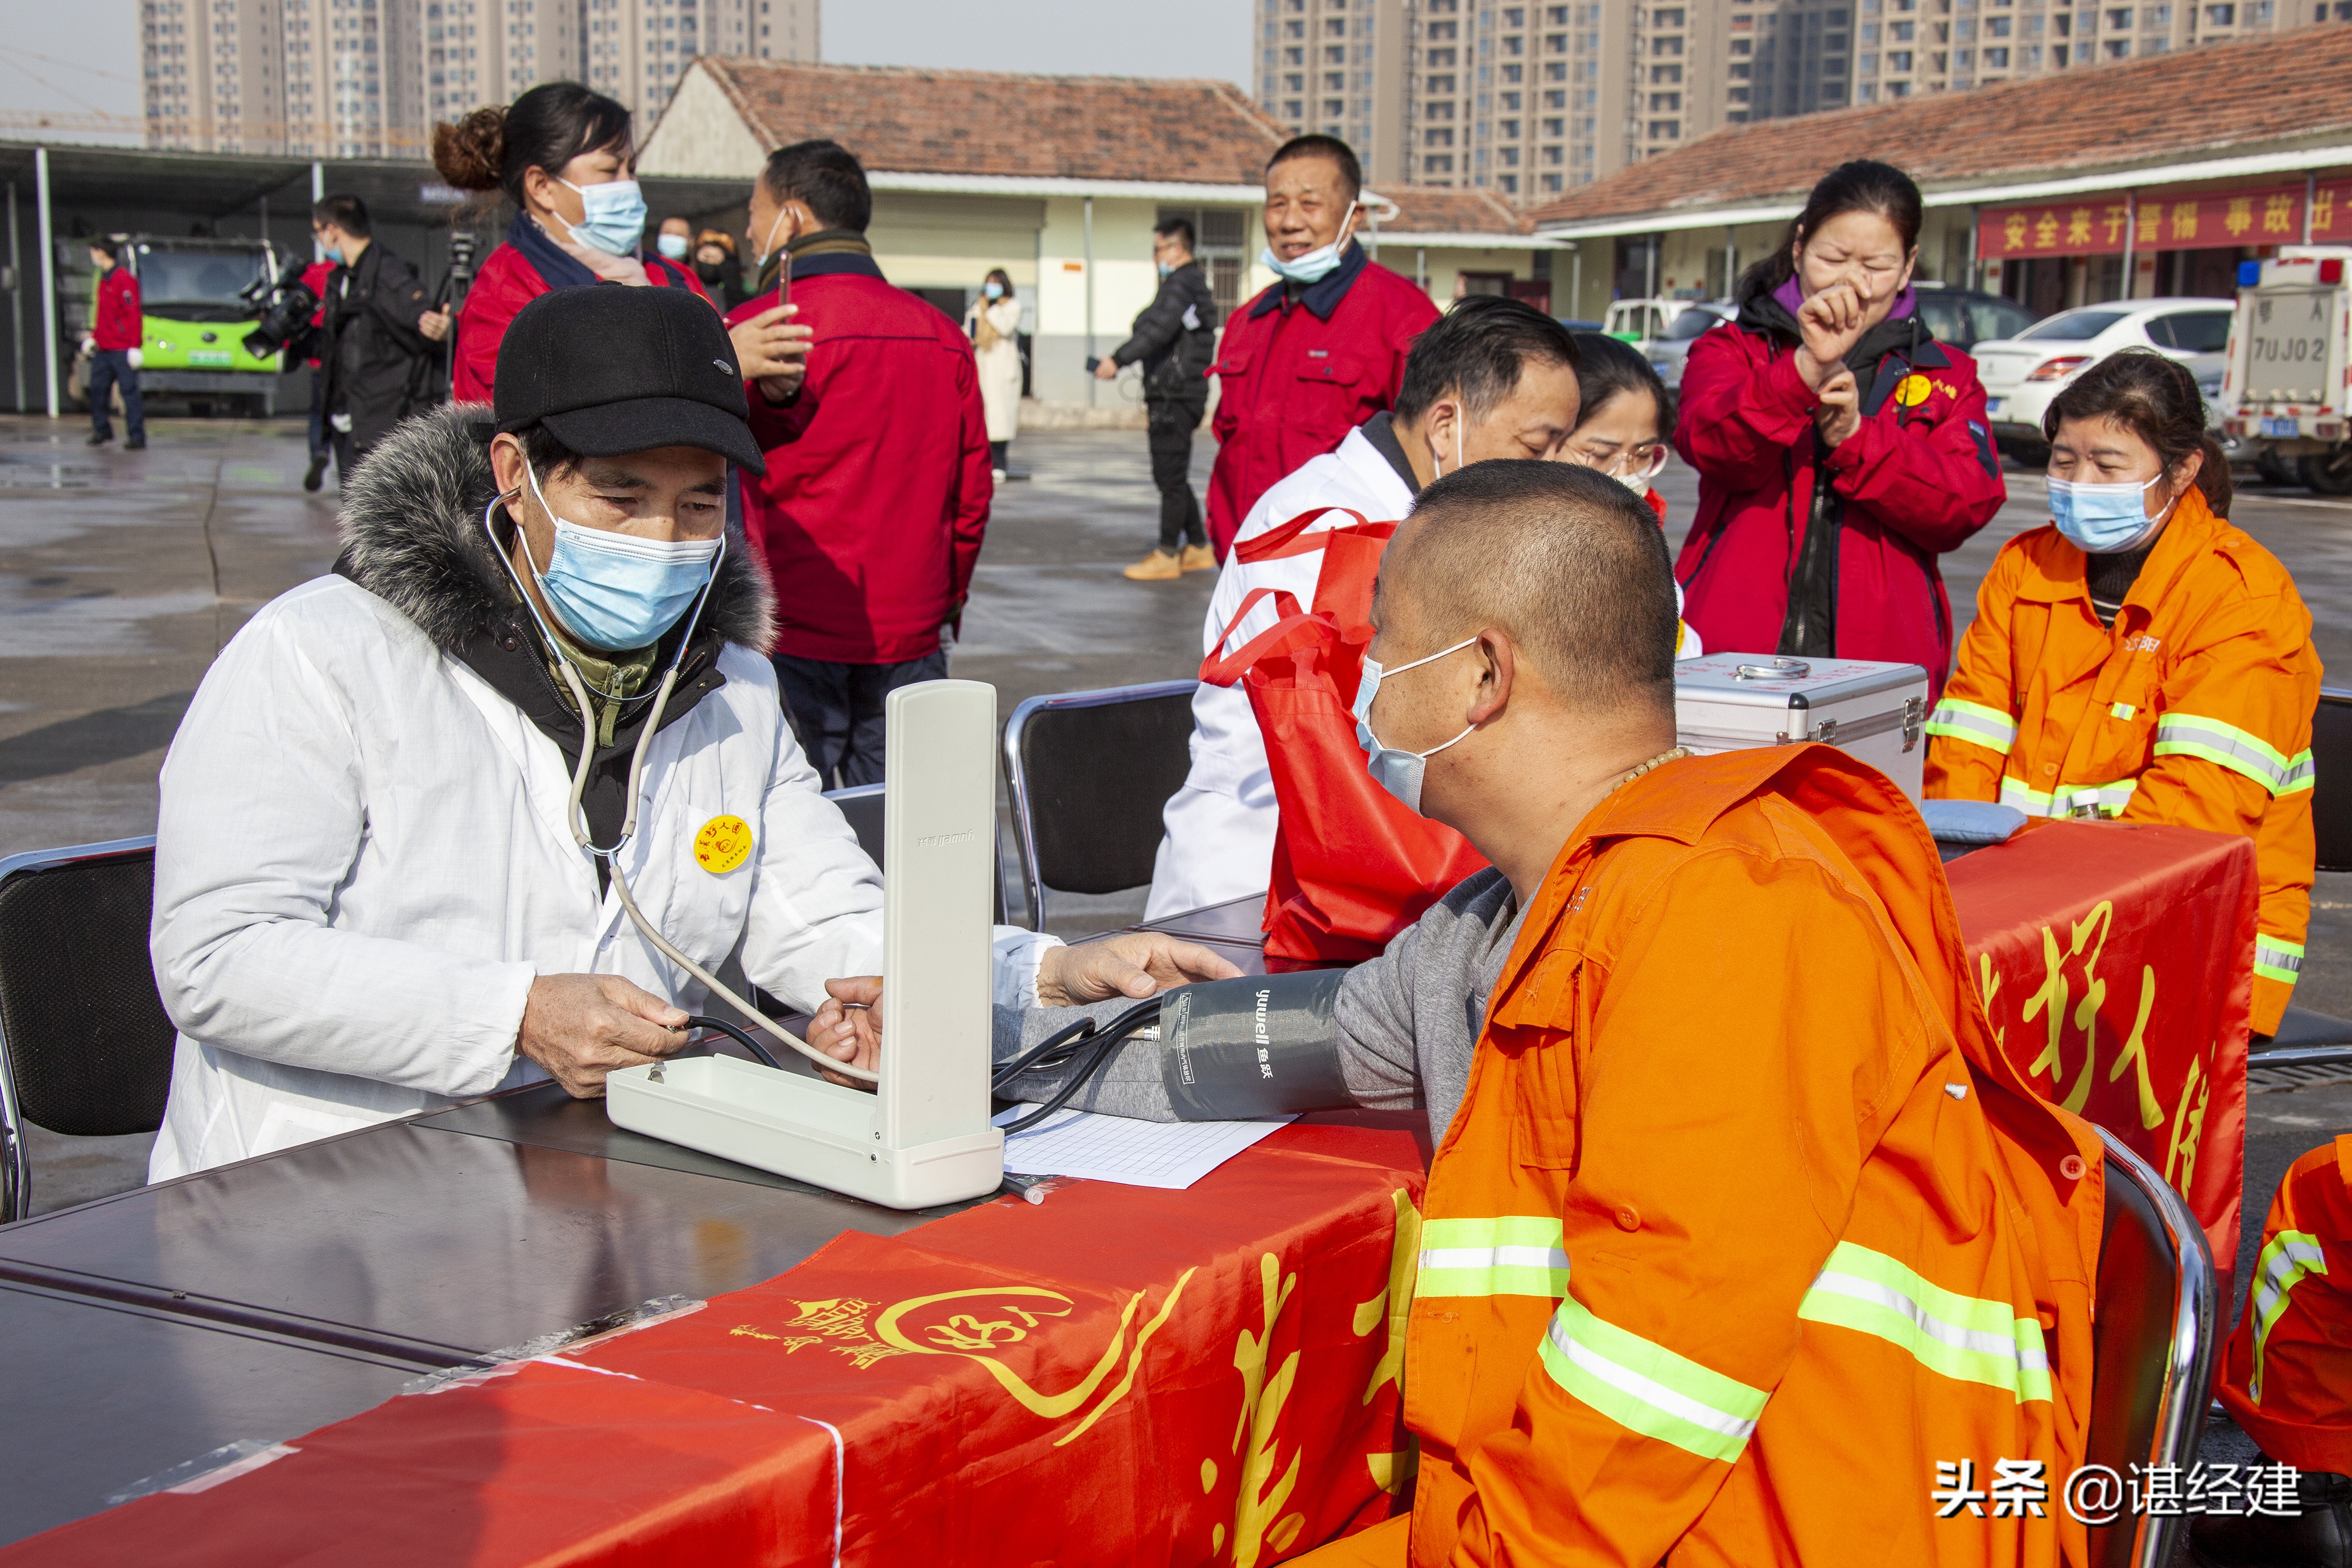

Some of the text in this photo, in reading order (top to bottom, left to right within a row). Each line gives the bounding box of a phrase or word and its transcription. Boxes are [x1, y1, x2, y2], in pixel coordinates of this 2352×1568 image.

[2223, 188, 2352, 238] 事故出
[2254, 337, 2325, 362] 7UJ02
[938, 829, 974, 847] yuwell
[1255, 989, 1273, 1079] yuwell 鱼跃
